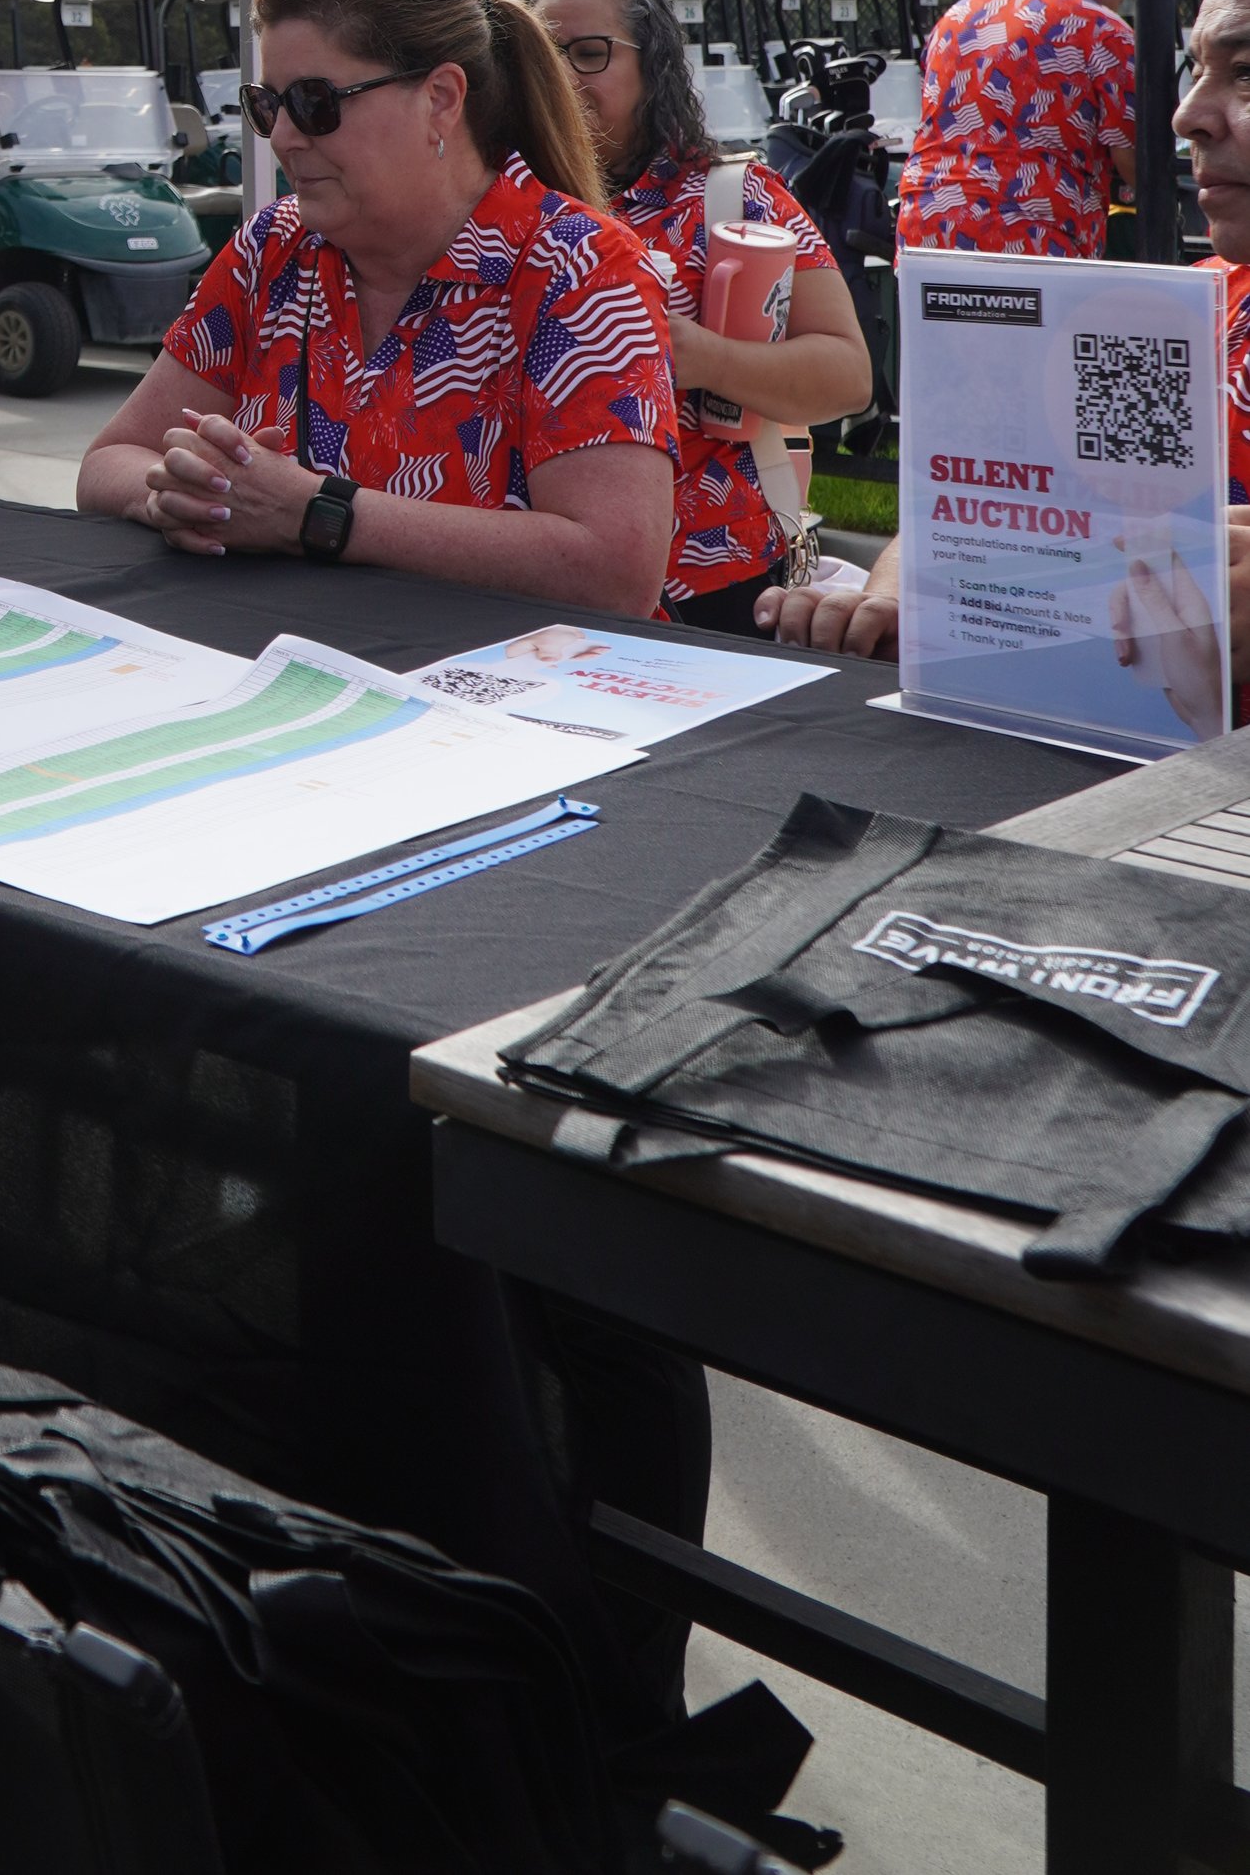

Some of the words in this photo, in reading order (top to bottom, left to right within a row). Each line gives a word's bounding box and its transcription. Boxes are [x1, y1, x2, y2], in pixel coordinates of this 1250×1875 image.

[926, 292, 1037, 310] FRONTWAVE
[956, 309, 1007, 319] foundation
[930, 454, 1054, 493] SILENT
[931, 494, 1091, 539] AUCTION
[932, 532, 1018, 552] Congratulations
[1020, 545, 1035, 555] on
[1036, 547, 1082, 563] winning
[932, 549, 957, 560] your
[959, 579, 987, 592] Scan
[988, 583, 1007, 595] the
[1009, 586, 1026, 598] QR
[1027, 589, 1056, 602] code
[960, 597, 983, 609] Add
[984, 600, 1002, 612] Bid
[1004, 603, 1050, 618] Amount
[1053, 610, 1062, 620] &
[1063, 611, 1092, 624] Note
[960, 614, 983, 625] Add
[984, 617, 1036, 635] Payment
[960, 630, 996, 646] Thank
[997, 637, 1023, 650] you!
[578, 681, 710, 709] SILENT
